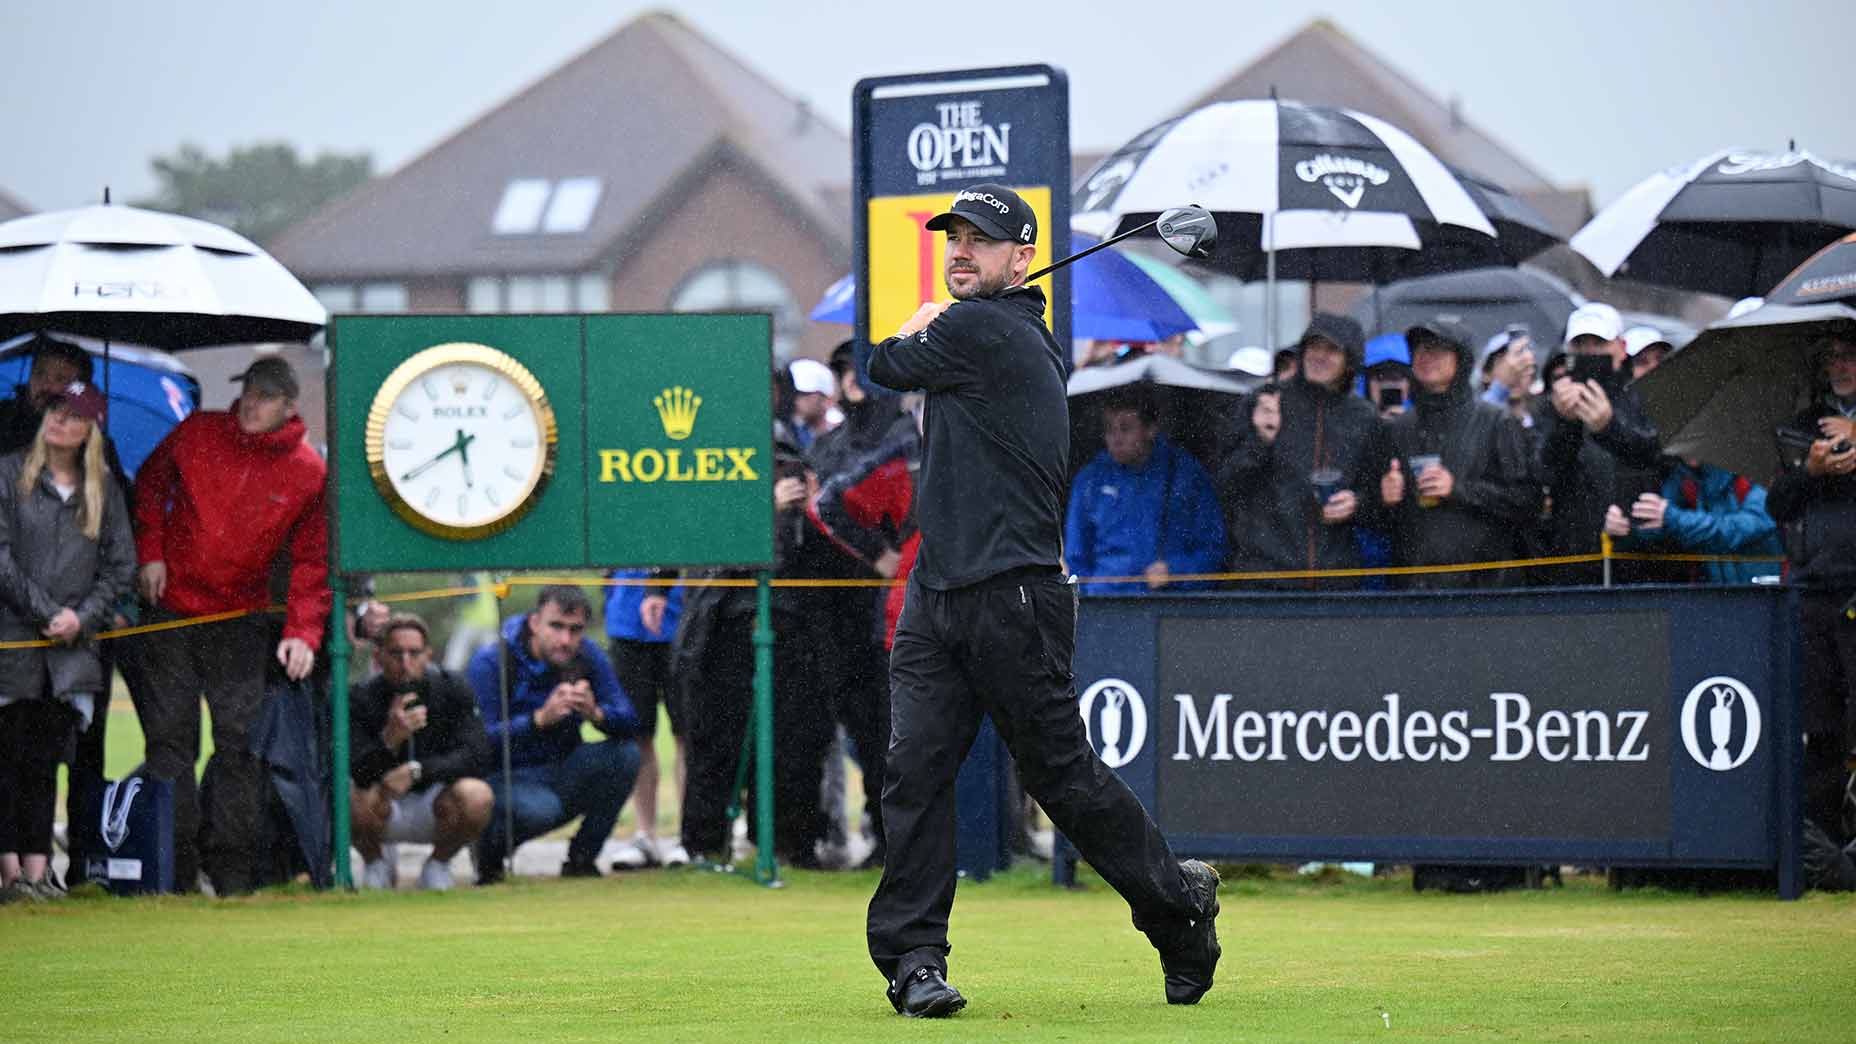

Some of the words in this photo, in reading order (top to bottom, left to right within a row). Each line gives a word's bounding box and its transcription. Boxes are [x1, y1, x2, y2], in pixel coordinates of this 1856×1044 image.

[936, 101, 984, 129] THE
[907, 122, 1011, 172] OPEN
[598, 447, 760, 483] ROLEX
[1172, 692, 1649, 762] Mercedes-Benz
